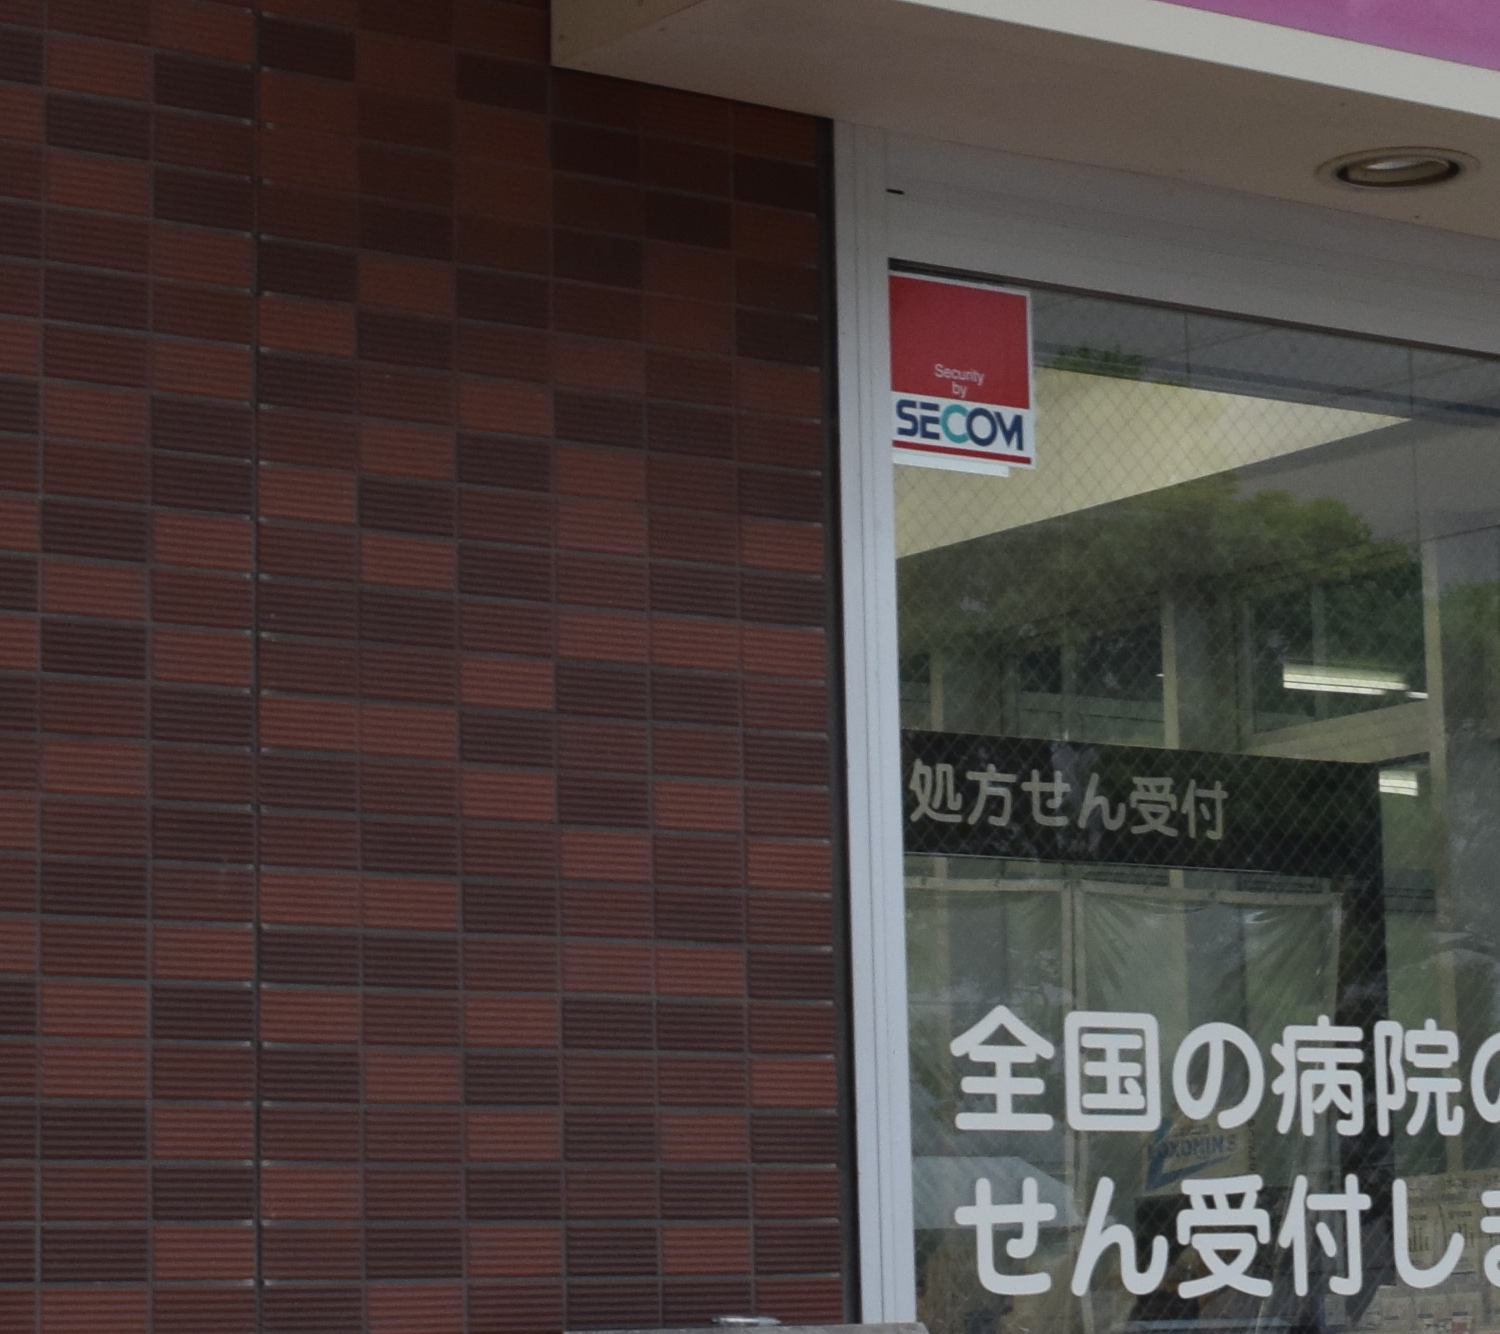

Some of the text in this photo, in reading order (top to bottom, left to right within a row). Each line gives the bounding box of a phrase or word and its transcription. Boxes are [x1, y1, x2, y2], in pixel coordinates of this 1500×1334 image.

[934, 363, 985, 386] Security
[951, 380, 968, 399] by
[895, 398, 1024, 451] SECOM
[908, 758, 1229, 841] 処方せん受付
